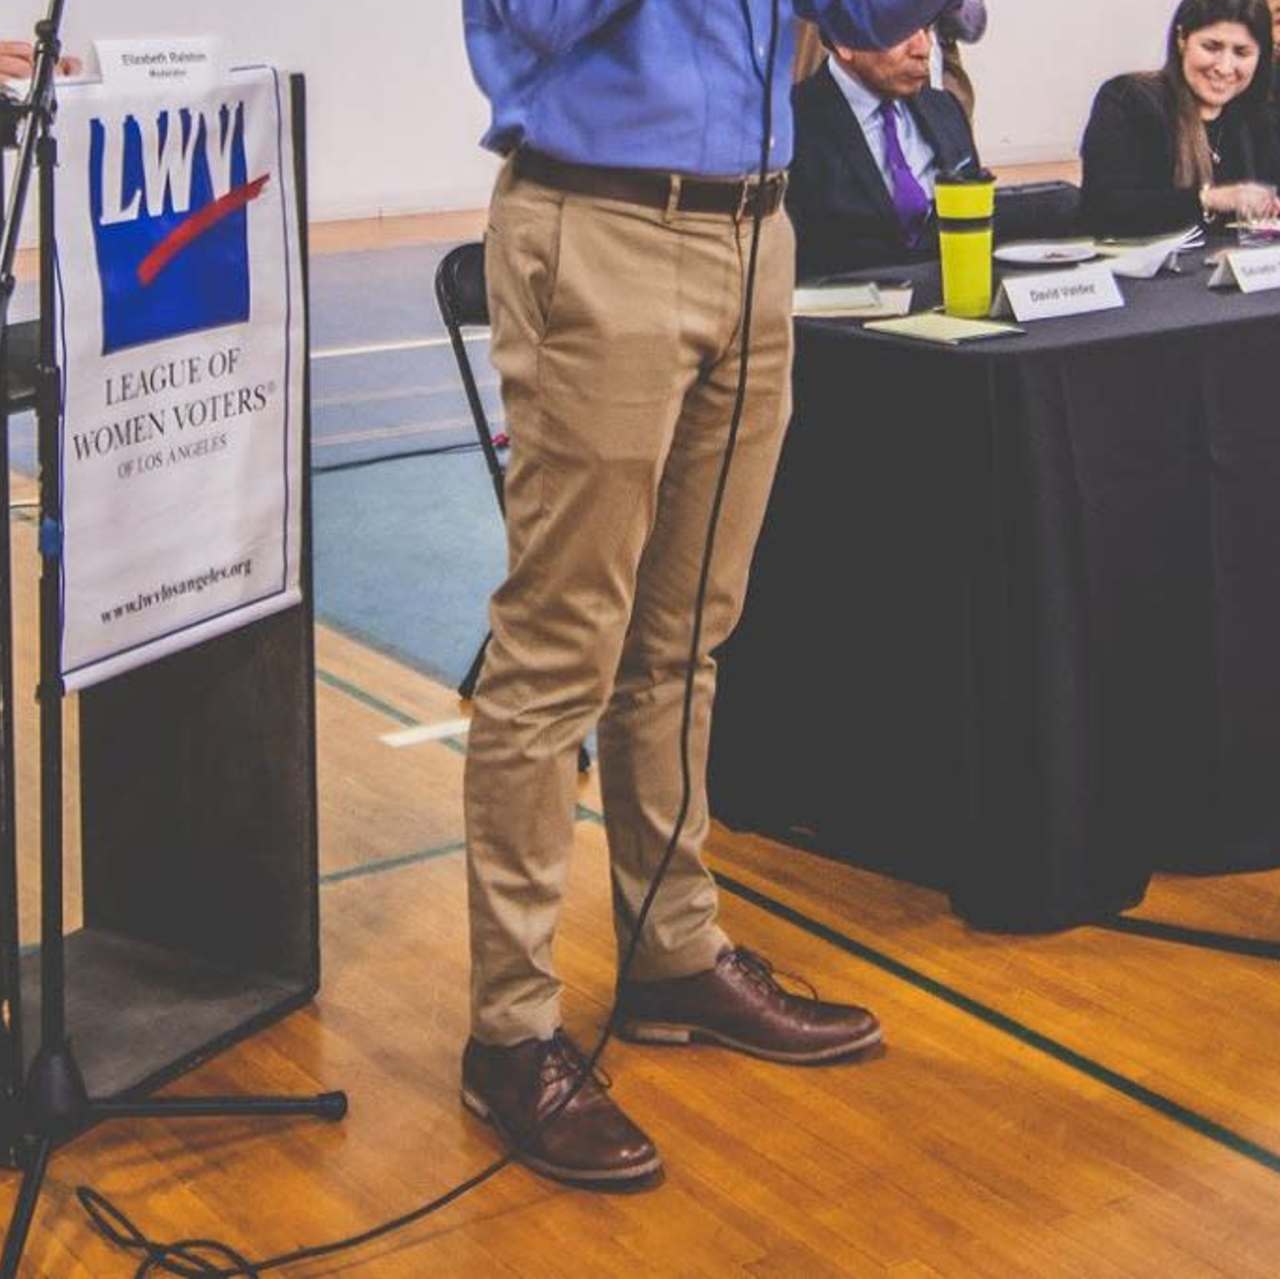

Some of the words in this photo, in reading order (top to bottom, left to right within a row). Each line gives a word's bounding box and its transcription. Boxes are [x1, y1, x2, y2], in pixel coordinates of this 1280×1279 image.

[100, 103, 238, 226] LWV
[105, 356, 202, 407] LEAGUE
[207, 347, 242, 380] OF
[72, 410, 167, 462] WOMEN
[117, 456, 136, 480] OF
[137, 449, 163, 475] LOS
[166, 433, 228, 468] ANGELES
